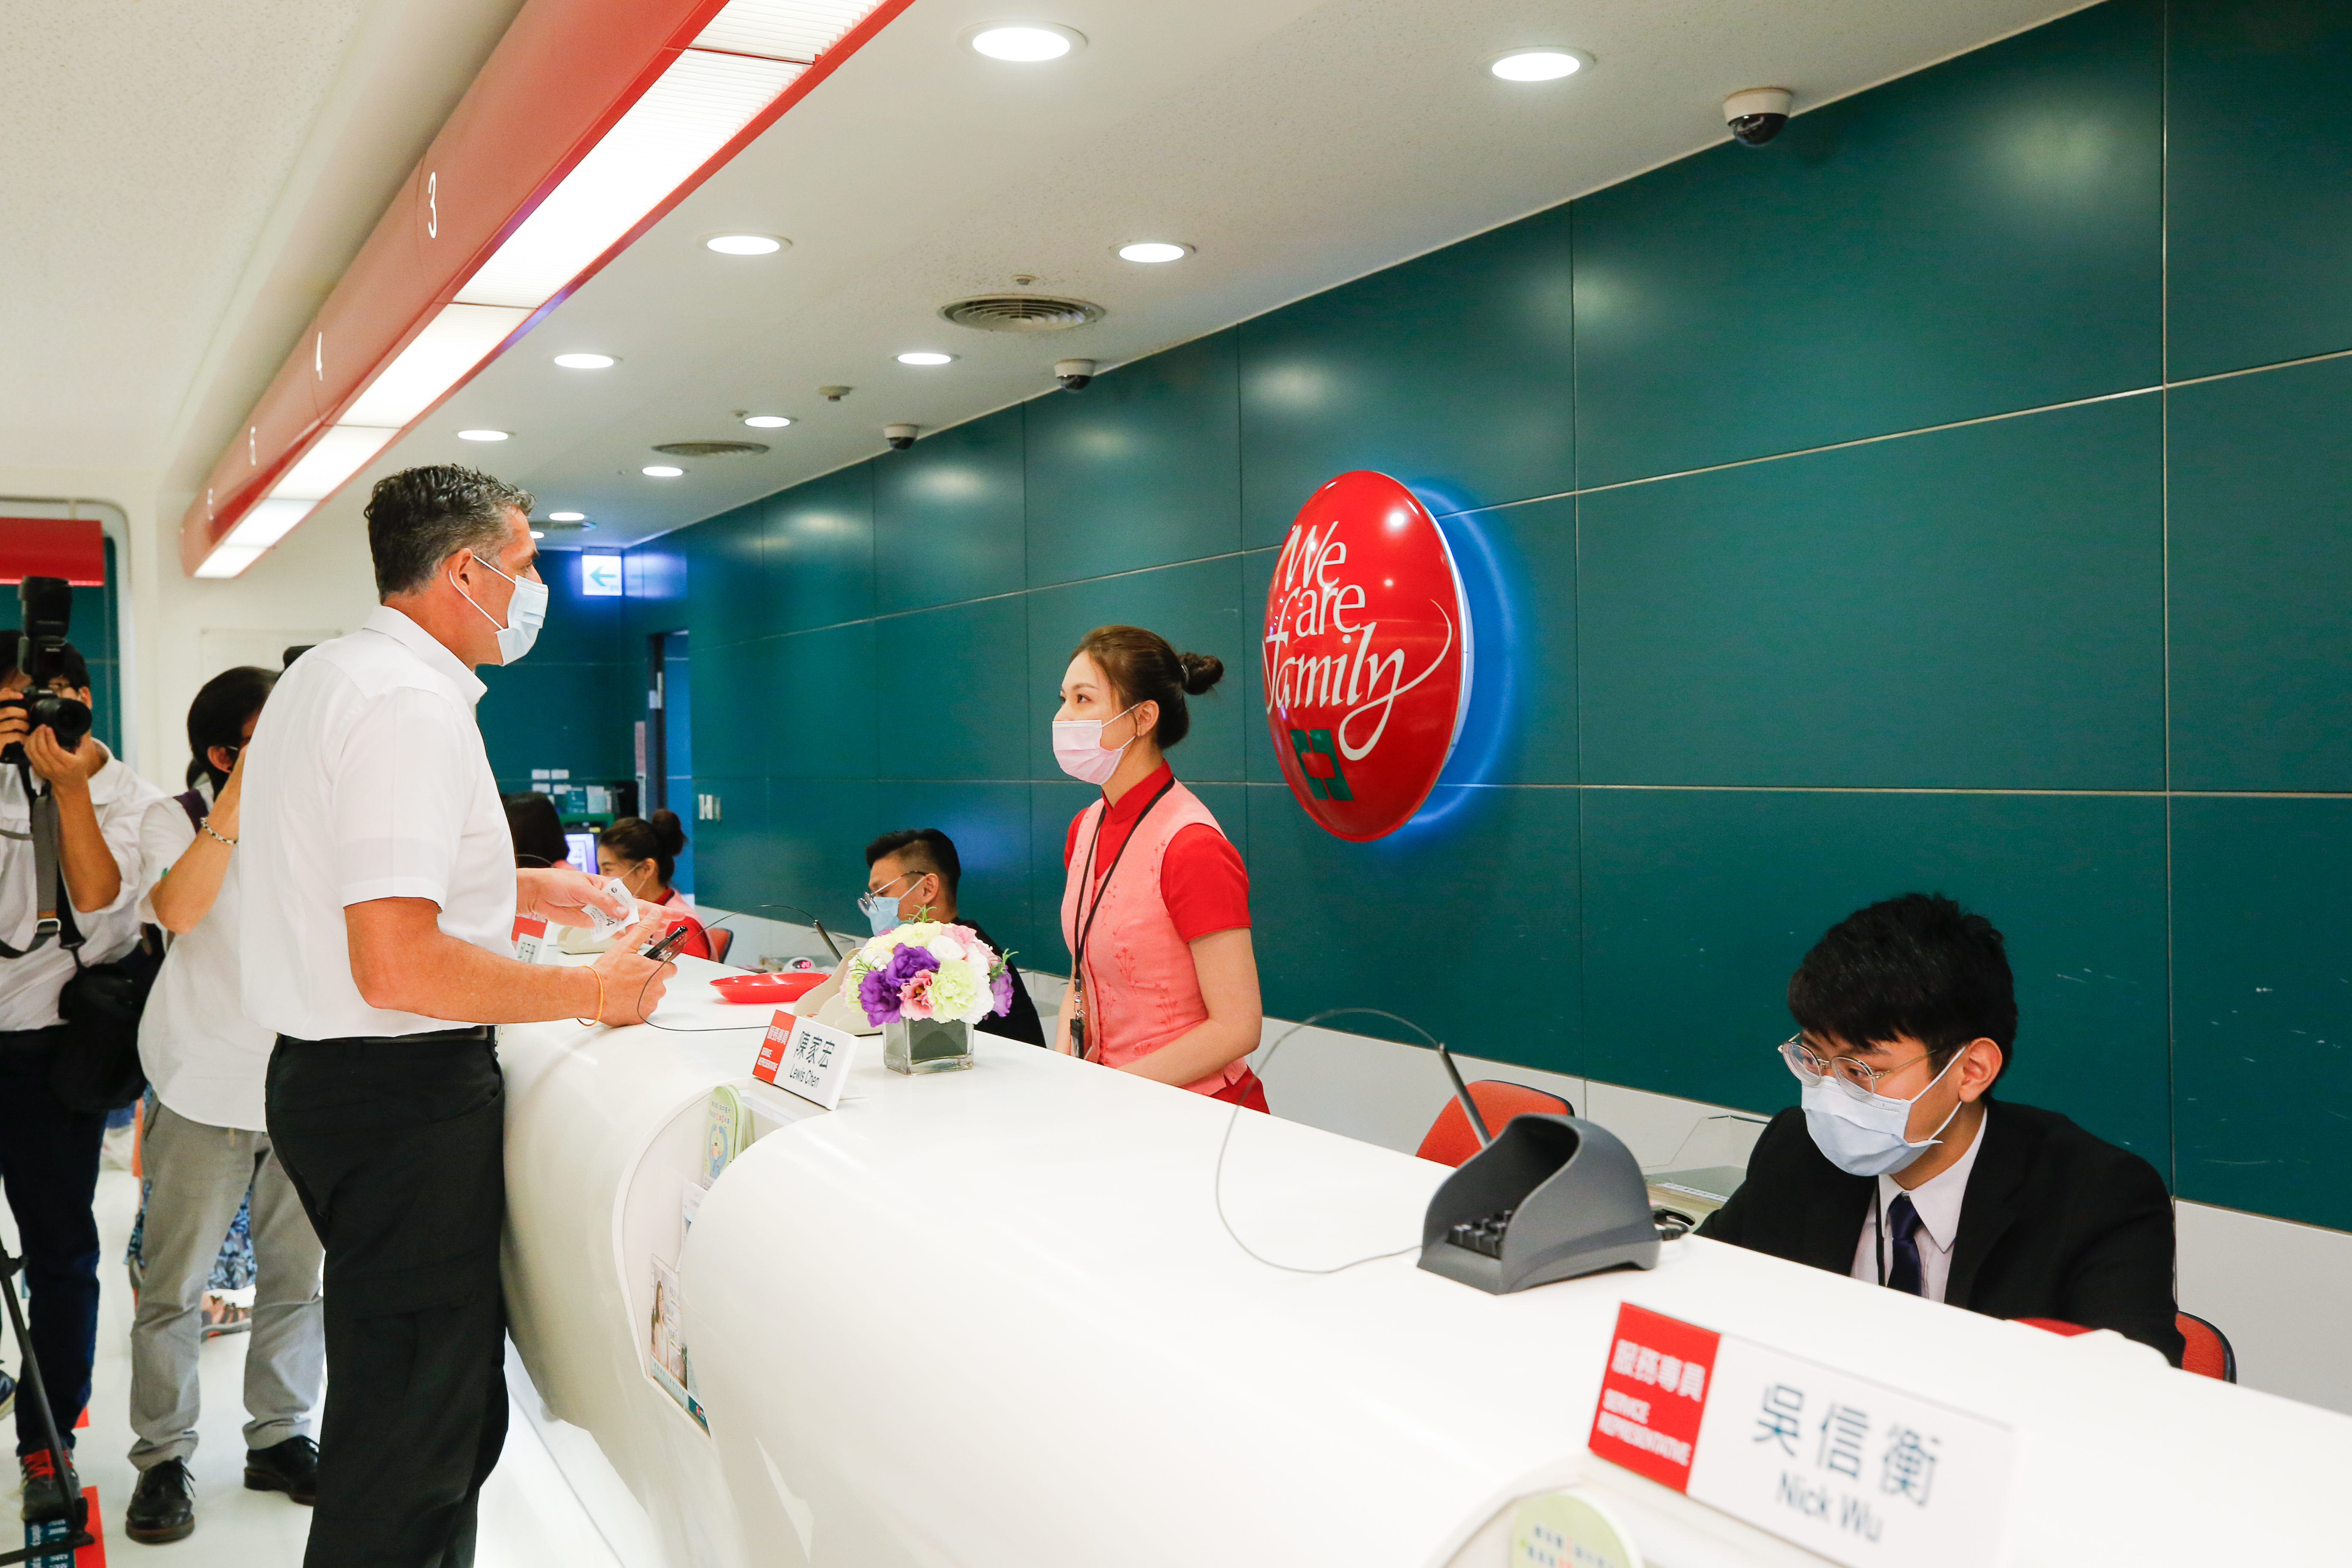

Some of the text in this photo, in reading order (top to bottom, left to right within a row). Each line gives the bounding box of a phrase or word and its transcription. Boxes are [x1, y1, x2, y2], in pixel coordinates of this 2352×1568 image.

[428, 171, 437, 239] 3
[1275, 520, 1347, 592] We
[1262, 599, 1452, 762] family
[789, 1063, 820, 1089] Lewis Chen
[793, 1031, 835, 1070] 陳家宏
[1752, 1384, 1941, 1508] 吳信衡
[1775, 1467, 1884, 1542] Nick Wu
